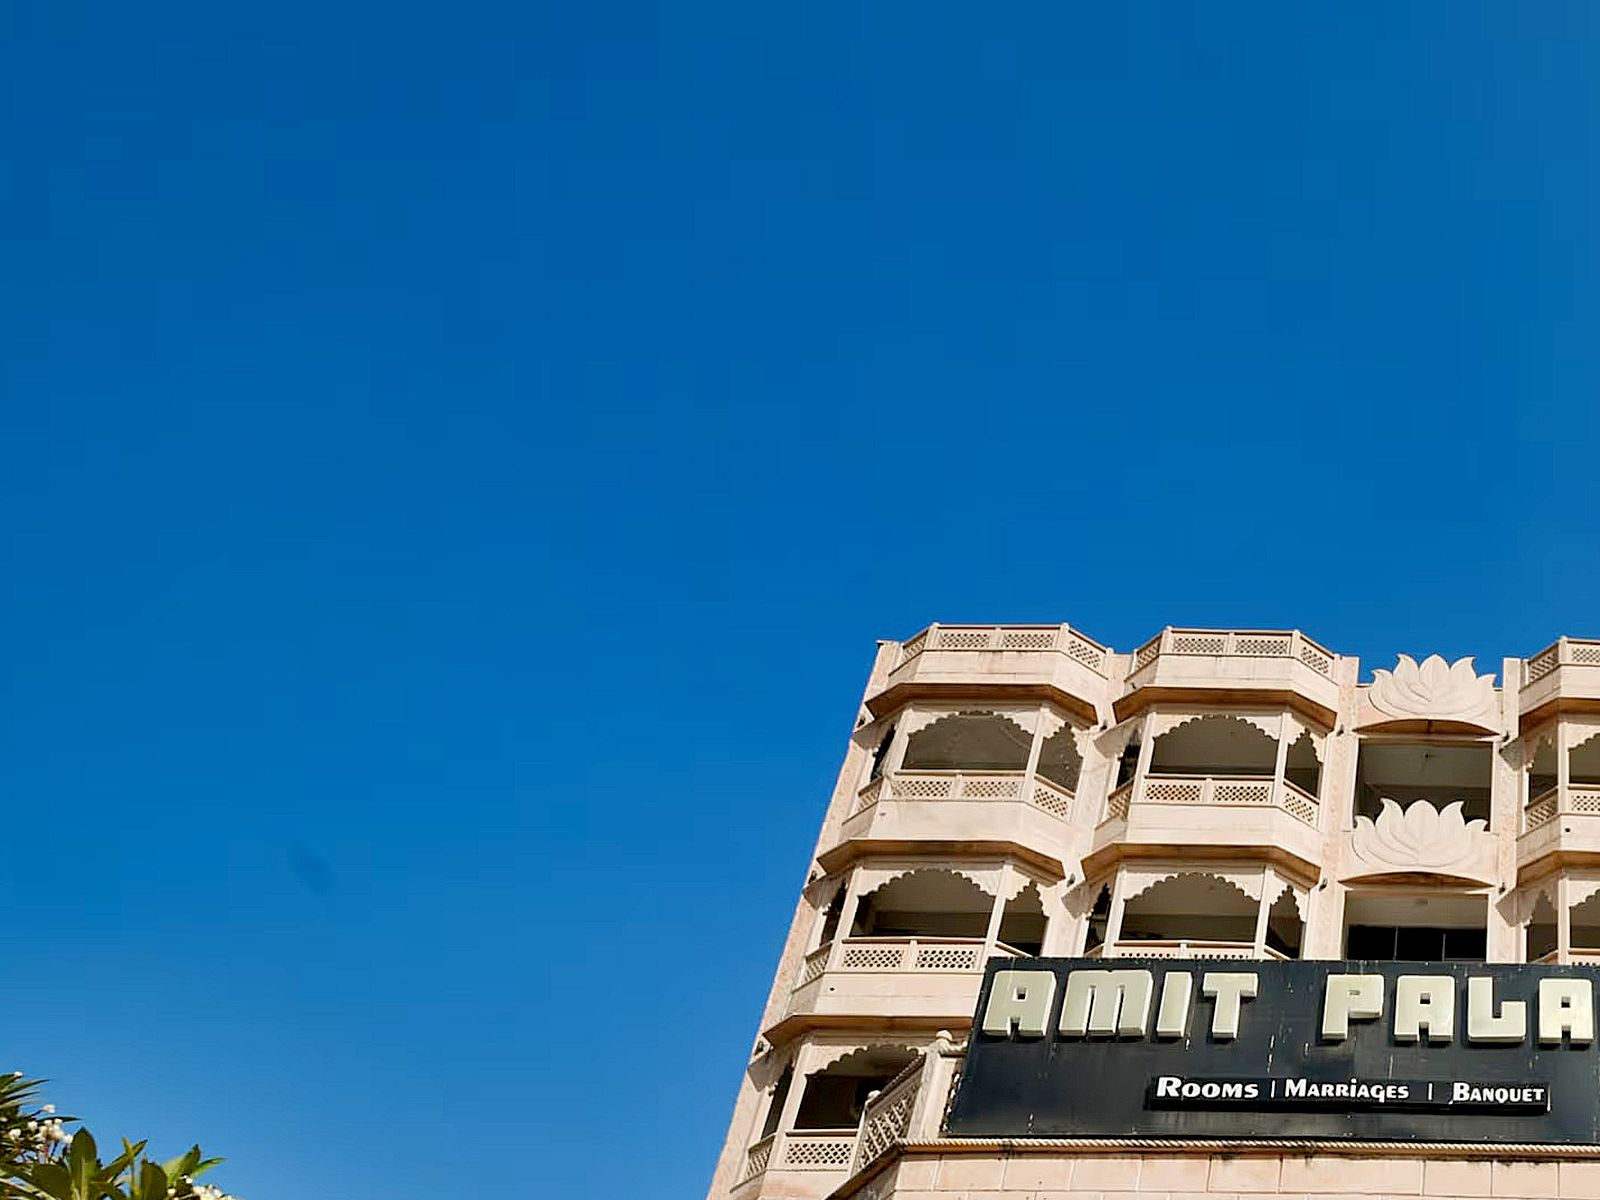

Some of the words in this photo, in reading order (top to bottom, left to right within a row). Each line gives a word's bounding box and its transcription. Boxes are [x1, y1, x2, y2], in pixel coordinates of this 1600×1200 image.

[981, 969, 1259, 1039] AMIT
[1156, 1075, 1260, 1099] ROOMS
[1284, 1077, 1410, 1104] MARRIAGES
[1451, 1081, 1546, 1104] BANQUET
